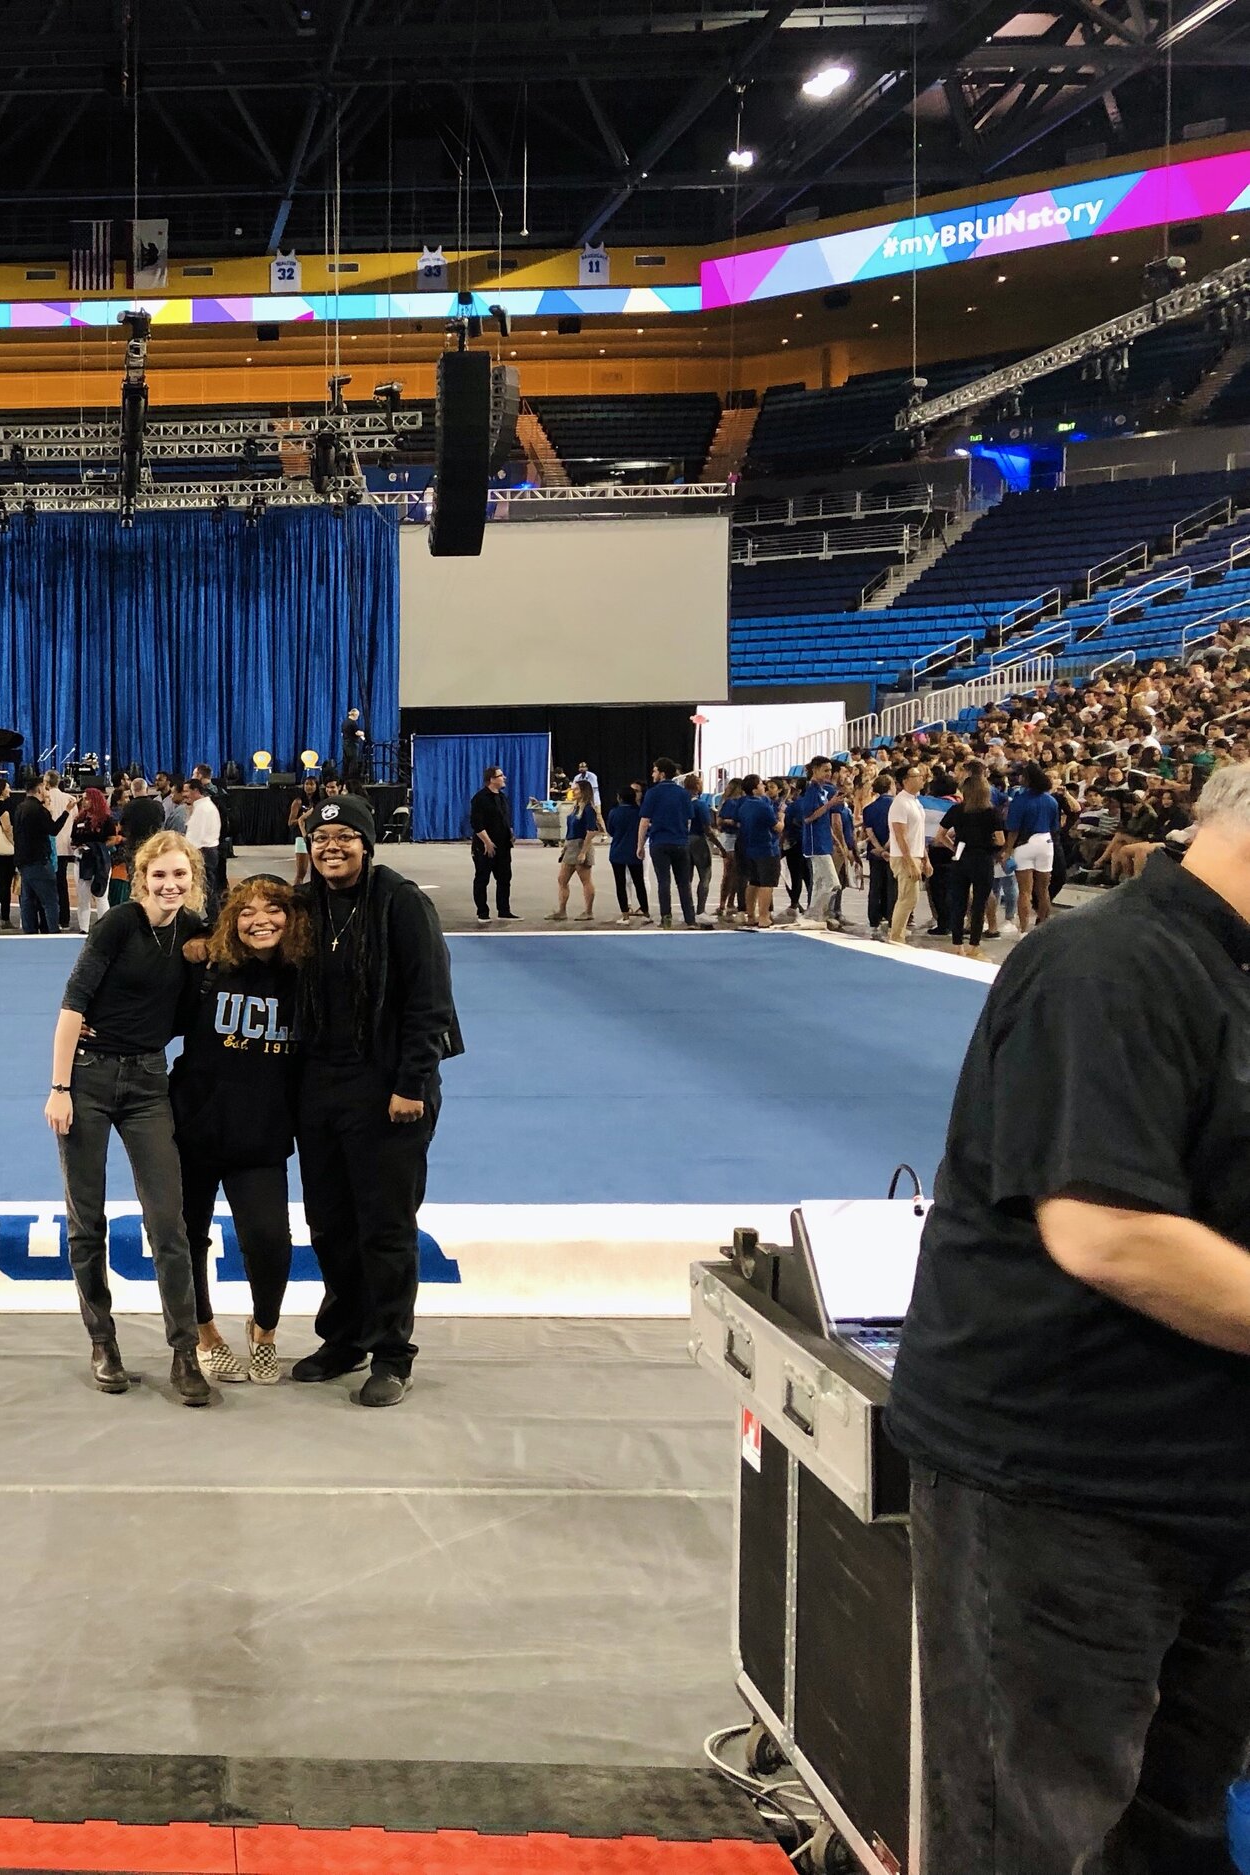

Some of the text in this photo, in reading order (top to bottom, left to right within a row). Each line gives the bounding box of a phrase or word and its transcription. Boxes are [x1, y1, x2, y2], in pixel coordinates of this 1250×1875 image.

[882, 199, 1104, 259] #myBRUINstory
[588, 260, 600, 273] 11
[277, 267, 295, 281] 32
[214, 991, 295, 1041] UCL
[263, 1042, 299, 1055] 191
